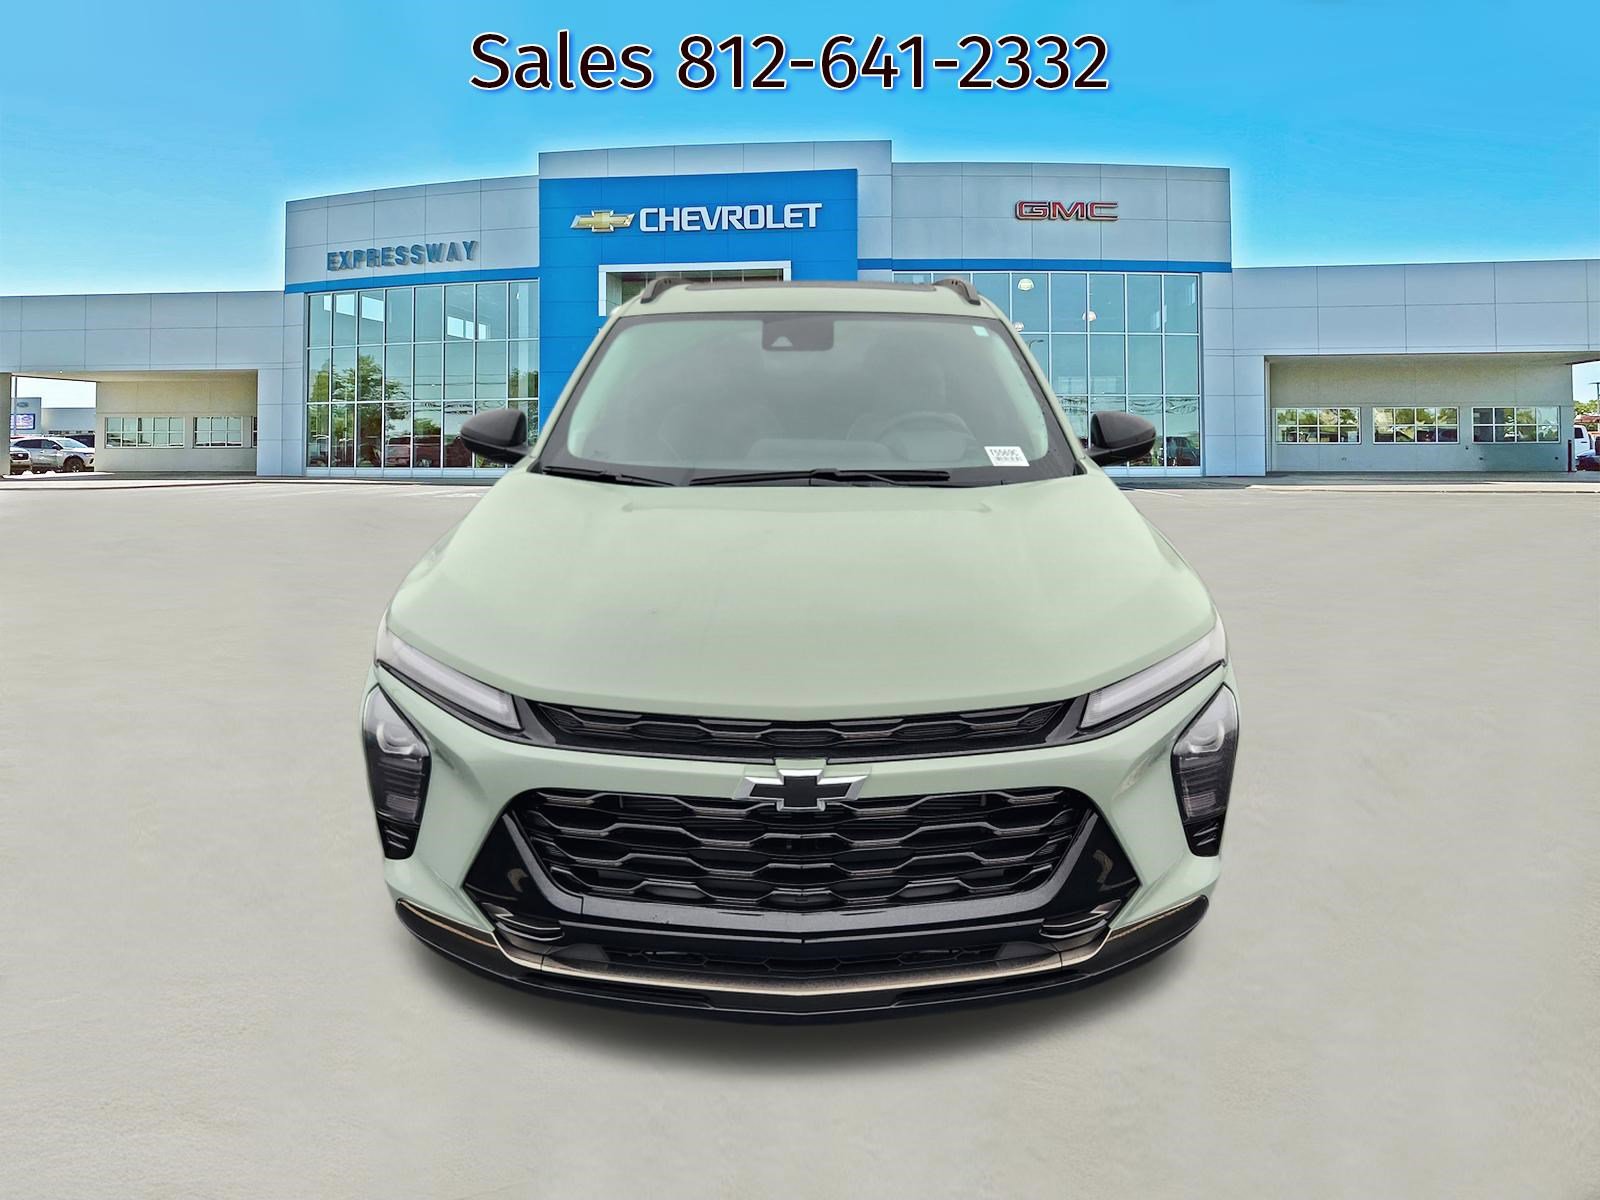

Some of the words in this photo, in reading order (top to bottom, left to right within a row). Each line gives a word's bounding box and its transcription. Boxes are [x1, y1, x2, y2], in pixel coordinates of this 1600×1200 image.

[639, 202, 823, 232] CHEVROLET
[1015, 200, 1119, 221] GMC
[327, 240, 479, 271] EXPRESSWAY
